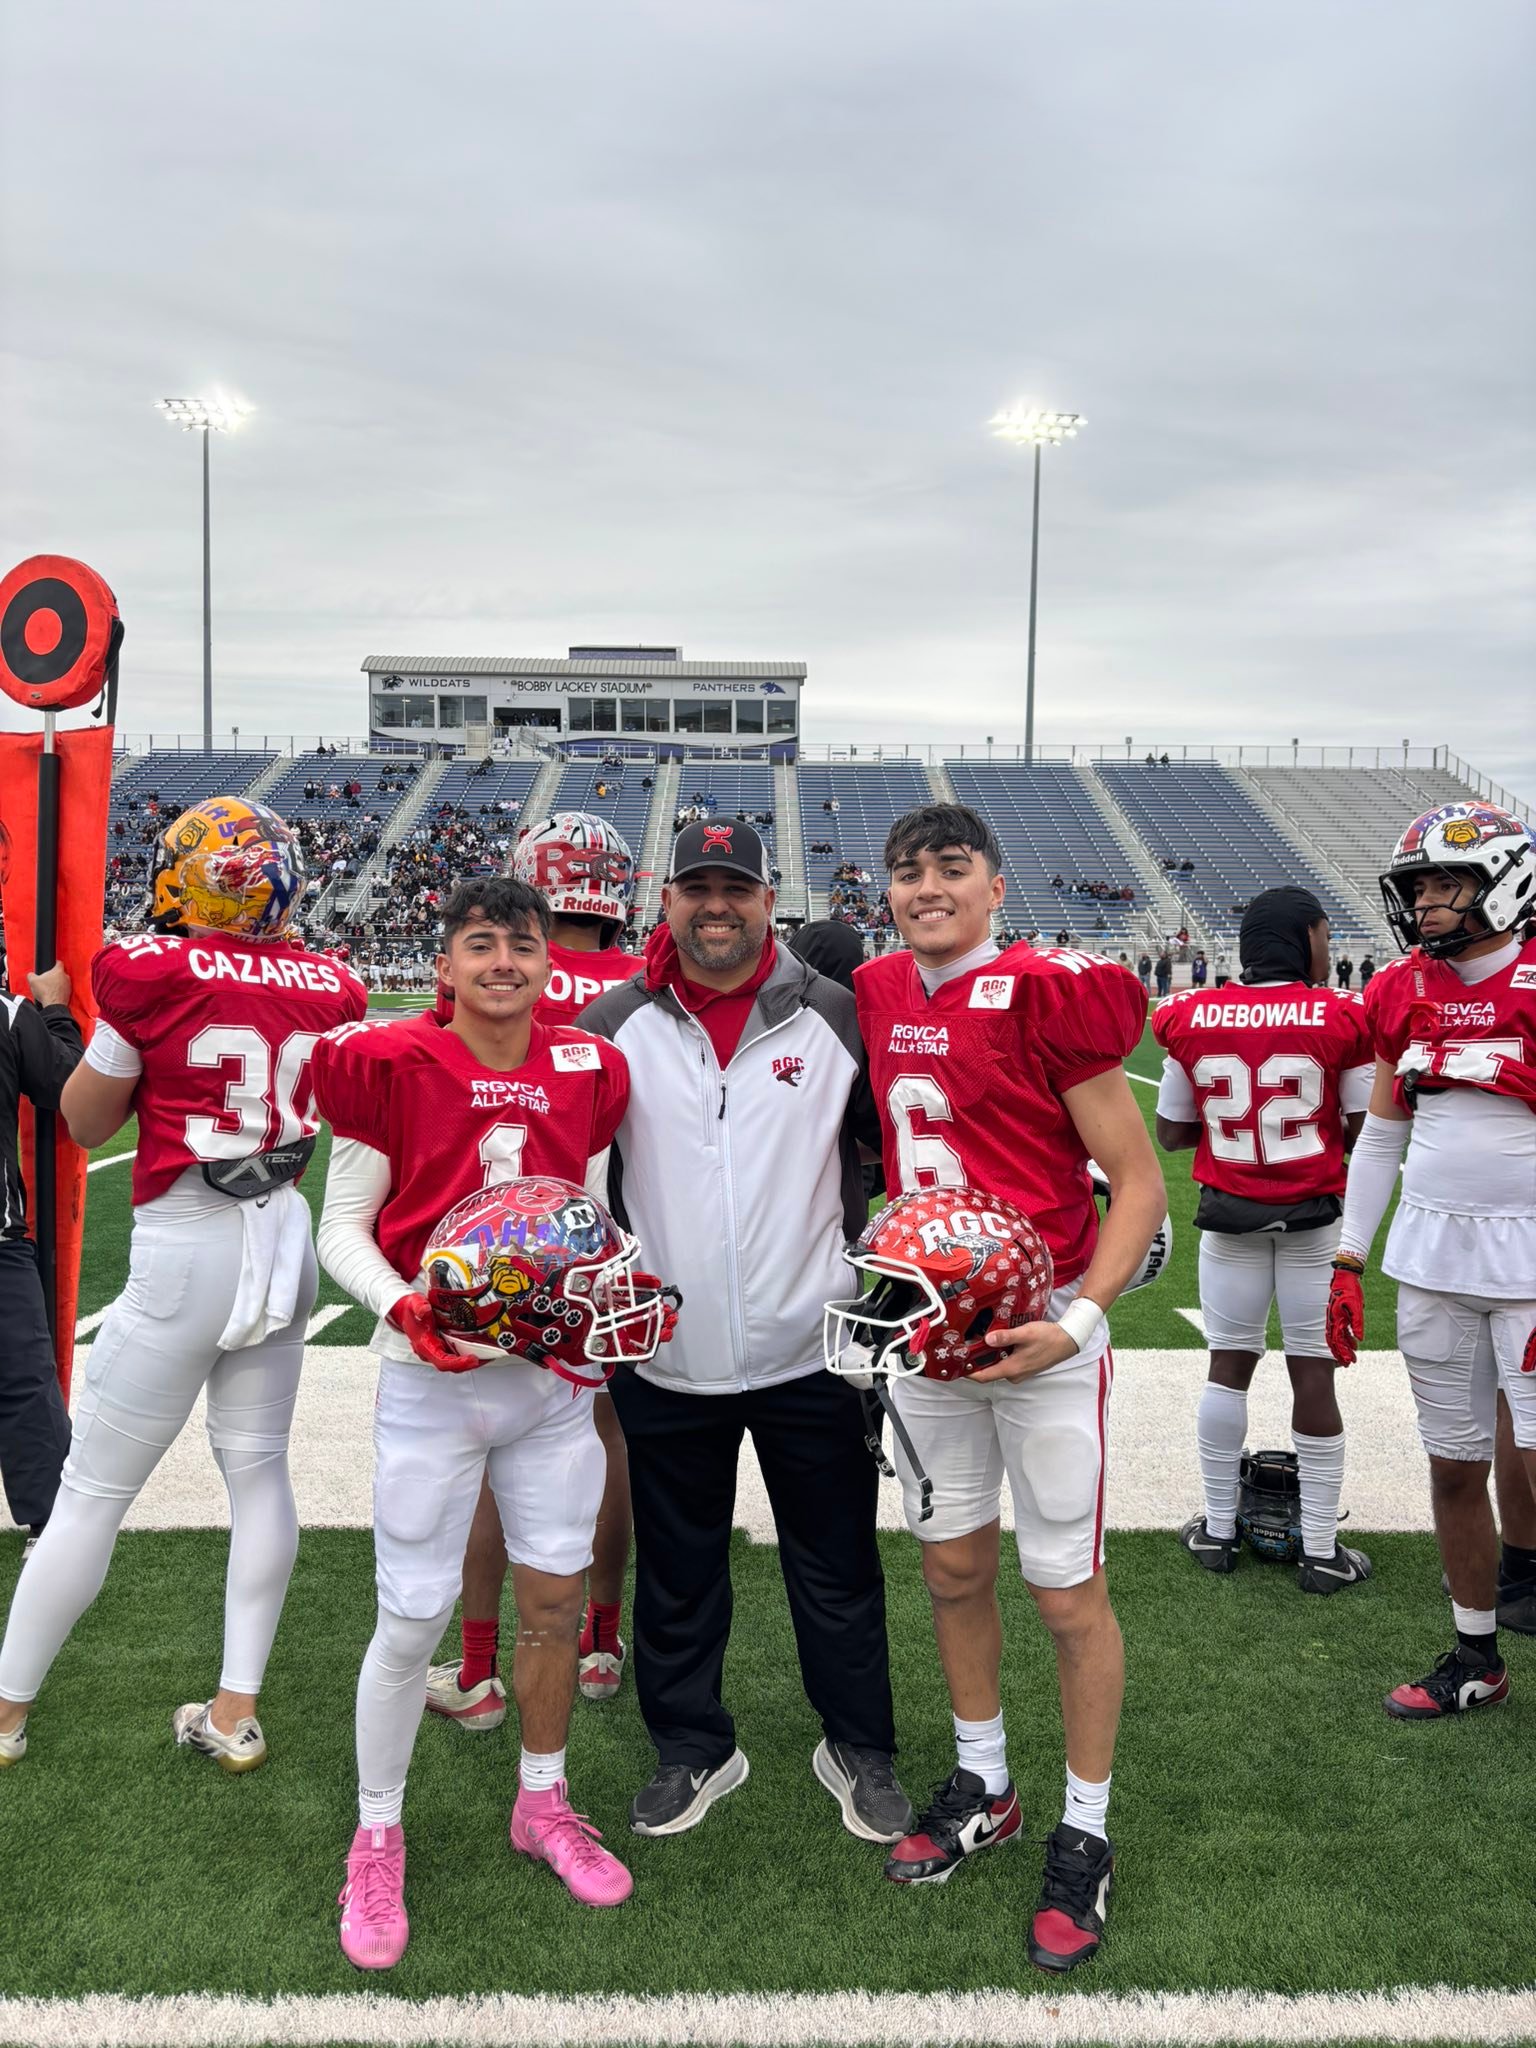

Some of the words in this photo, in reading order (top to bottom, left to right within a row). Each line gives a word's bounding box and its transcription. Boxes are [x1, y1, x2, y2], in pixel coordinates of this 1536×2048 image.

[408, 678, 471, 688] WILDCATS
[517, 680, 552, 692] BOBBY
[556, 681, 598, 693] LACKEY
[600, 682, 646, 694] STADIUM
[693, 683, 756, 693] PANTHERS
[563, 896, 618, 916] Riddell
[188, 948, 341, 993] CAZARES
[1190, 1002, 1327, 1028] ADEBOWALE
[891, 1024, 949, 1042] RGVCA
[471, 1079, 548, 1101] RGVCA
[1192, 1053, 1326, 1165] 22
[887, 1073, 968, 1192] 6
[479, 1122, 527, 1188] 1
[917, 1210, 1012, 1257] RGC
[1141, 1226, 1166, 1282] UGLA
[1253, 1527, 1285, 1539] Riddell
